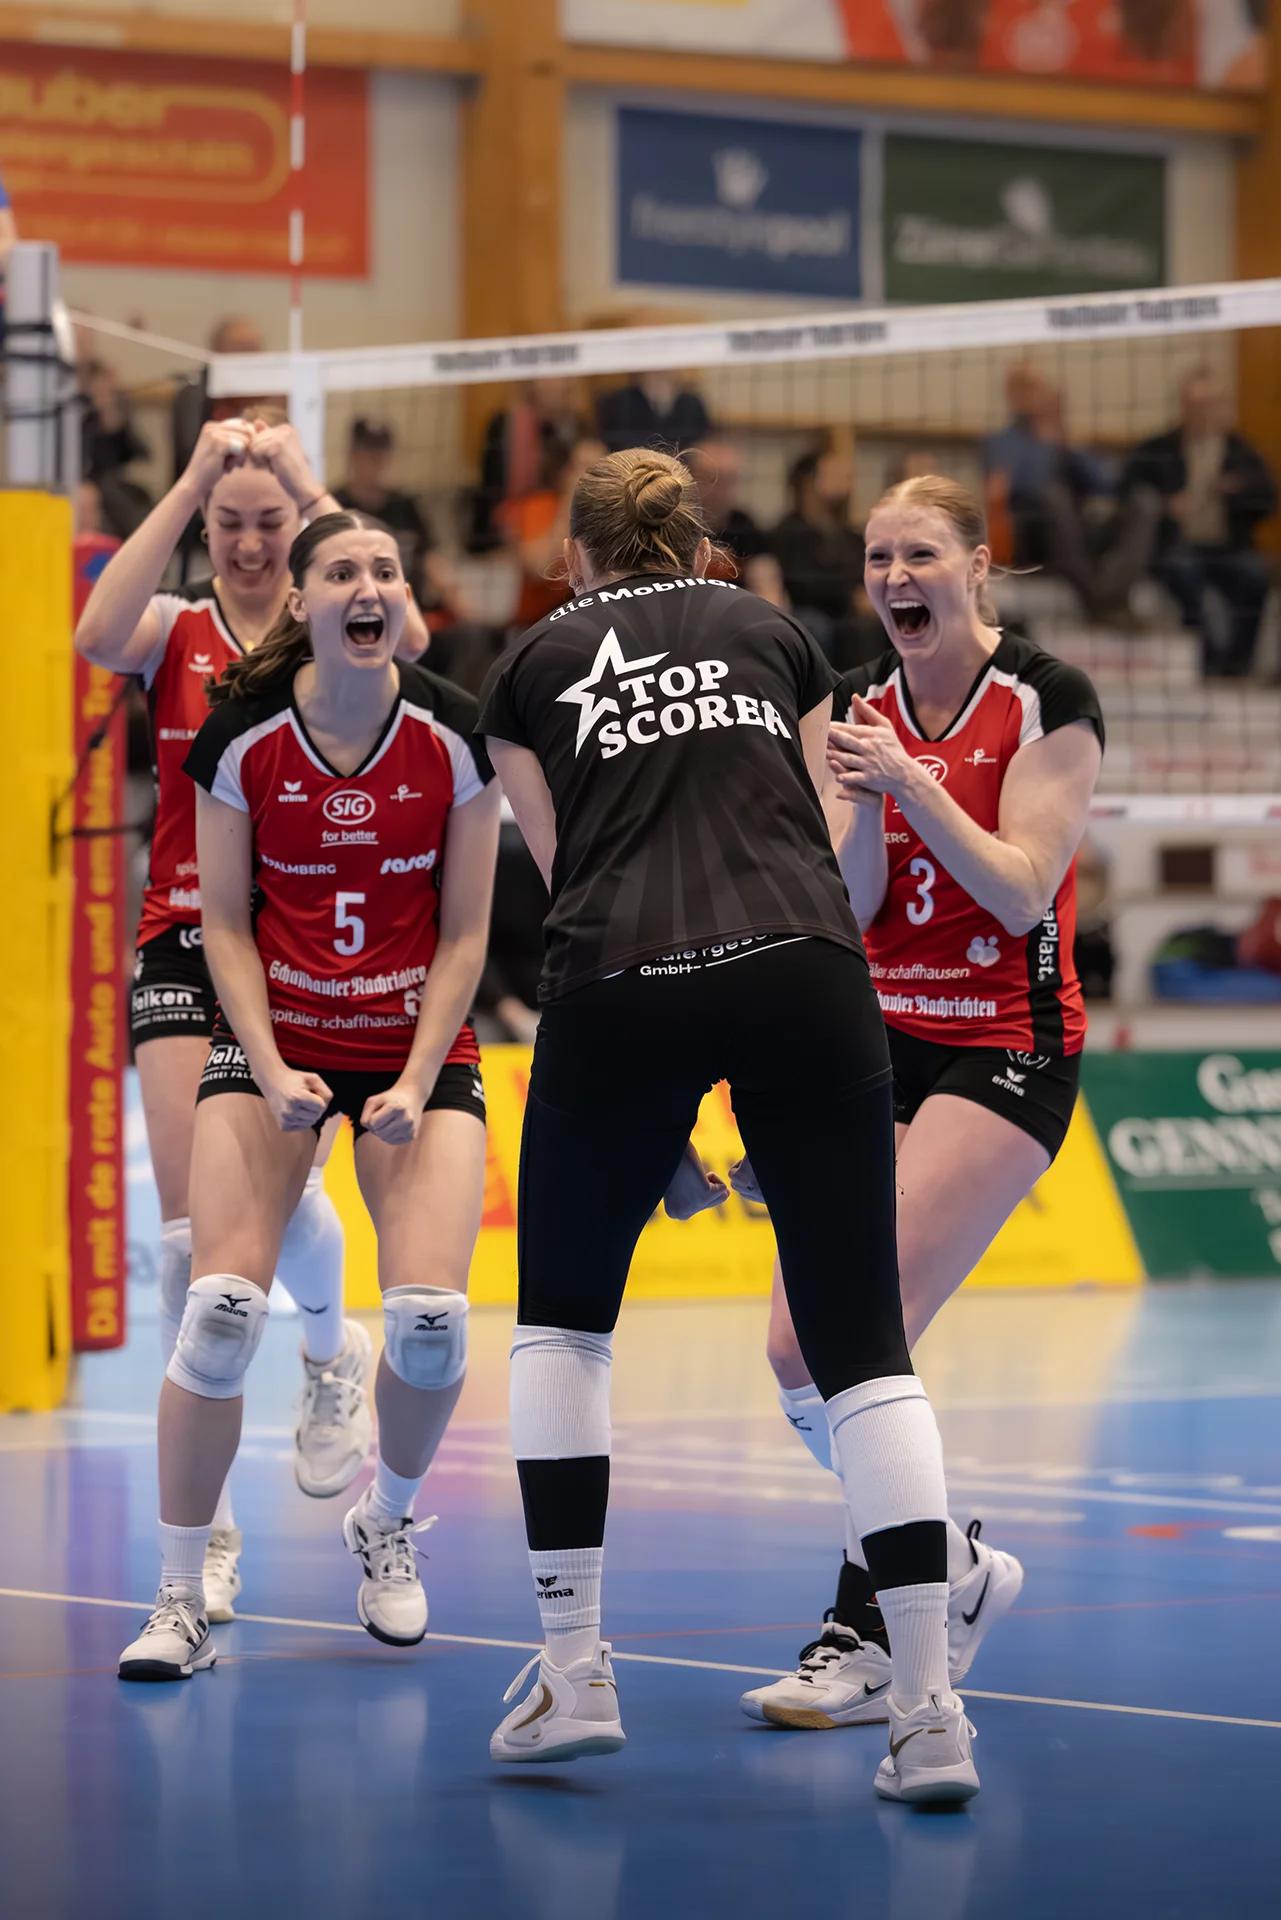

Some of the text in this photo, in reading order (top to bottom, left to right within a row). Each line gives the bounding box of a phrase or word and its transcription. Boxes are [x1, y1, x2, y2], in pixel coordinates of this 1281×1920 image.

[549, 576, 737, 622] die Mobiliar
[617, 659, 729, 709] TOP
[598, 694, 792, 760] SCORER
[278, 793, 308, 803] erima
[331, 796, 366, 817] SIG
[321, 829, 378, 843] for better
[268, 858, 336, 875] PALMBERG
[906, 857, 937, 926] 3
[334, 890, 366, 957] 5
[639, 963, 692, 976] GmbH
[886, 963, 971, 980] schaffhausen
[269, 1008, 416, 1030] spitäler schaffhausen
[914, 994, 998, 1019] Nachrichten
[84, 983, 116, 1073] Auto
[992, 1074, 1025, 1097] erima
[86, 1078, 116, 1154] rote
[85, 1162, 116, 1208] de
[85, 1218, 116, 1279] mit
[536, 1587, 575, 1600] erima
